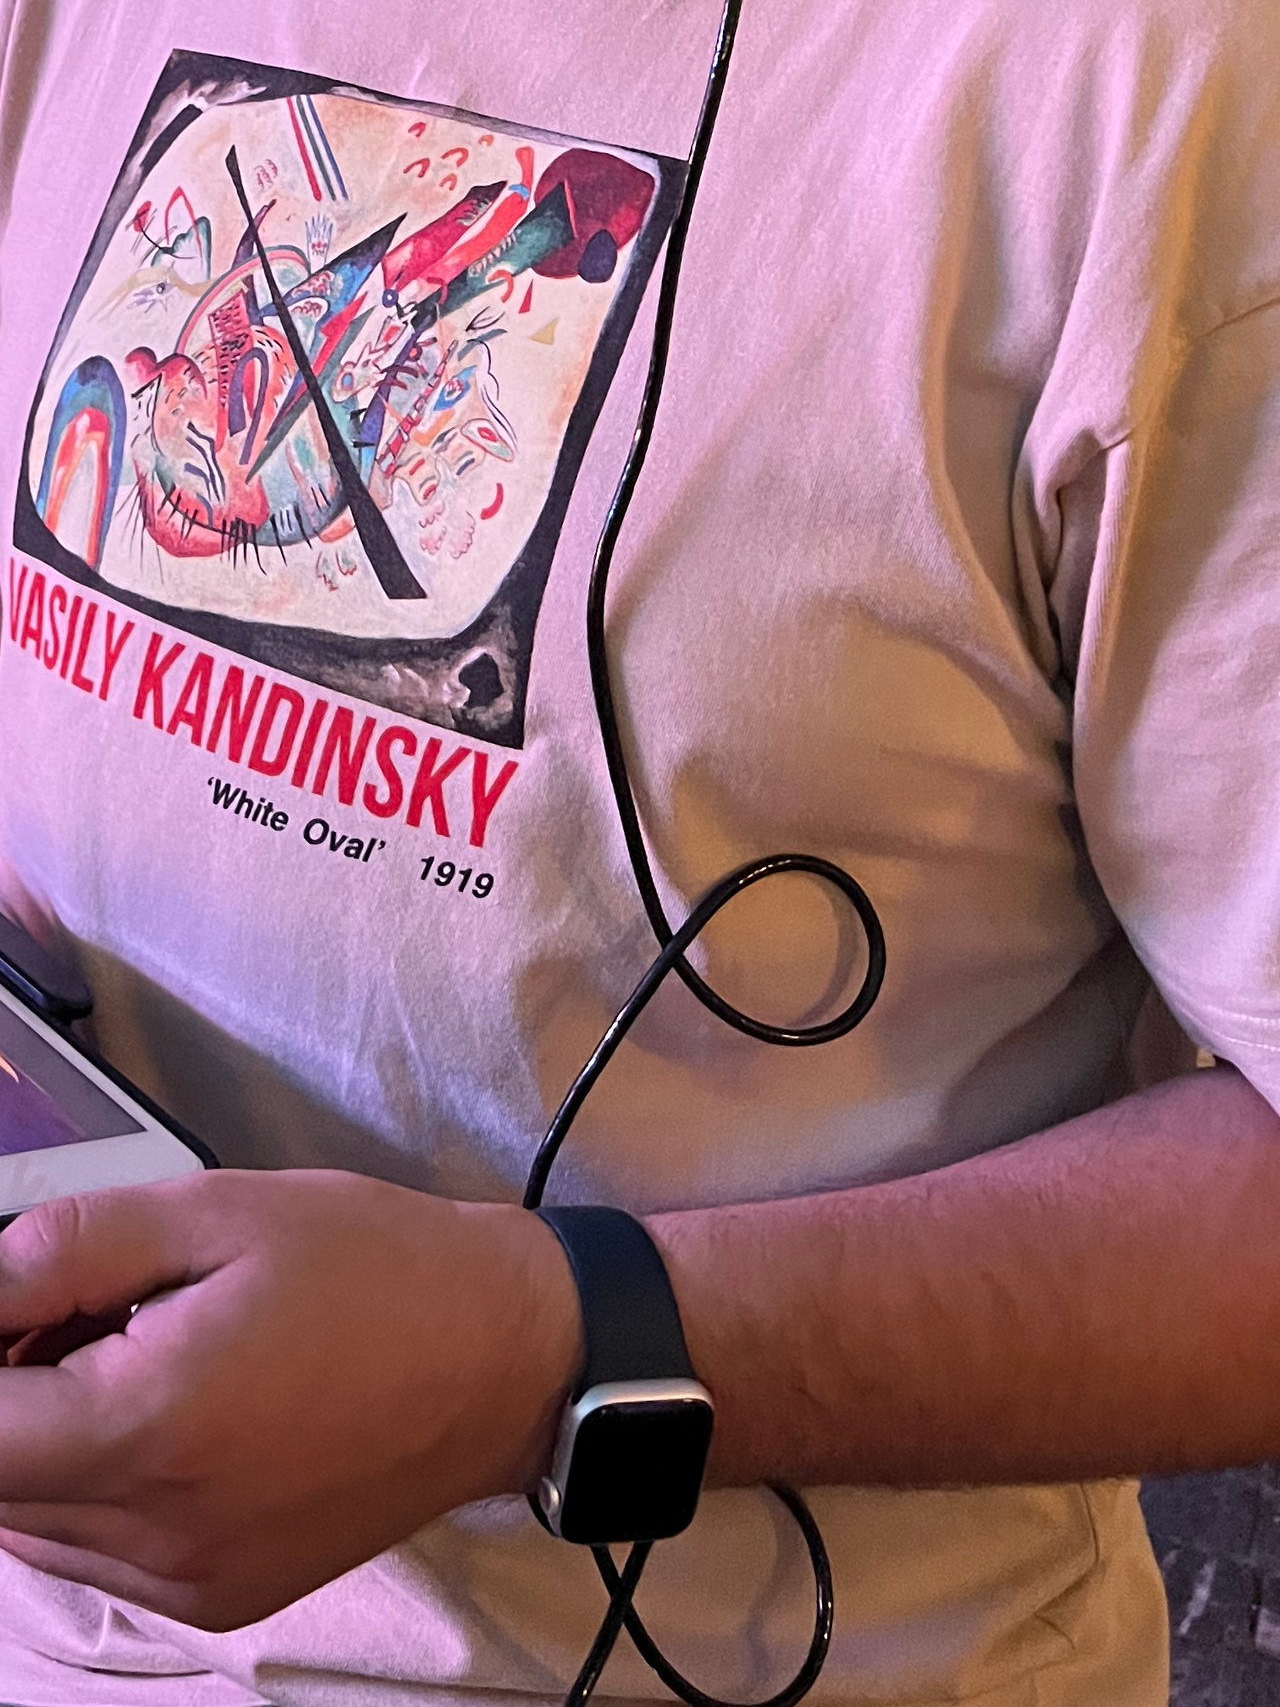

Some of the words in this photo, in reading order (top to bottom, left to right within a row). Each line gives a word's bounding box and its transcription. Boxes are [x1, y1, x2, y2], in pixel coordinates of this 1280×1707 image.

[7, 557, 136, 702] VASILY
[132, 632, 519, 849] KANDINSKY
[206, 776, 290, 833] 'White
[302, 818, 387, 864] Oval'
[419, 855, 495, 899] 1919
